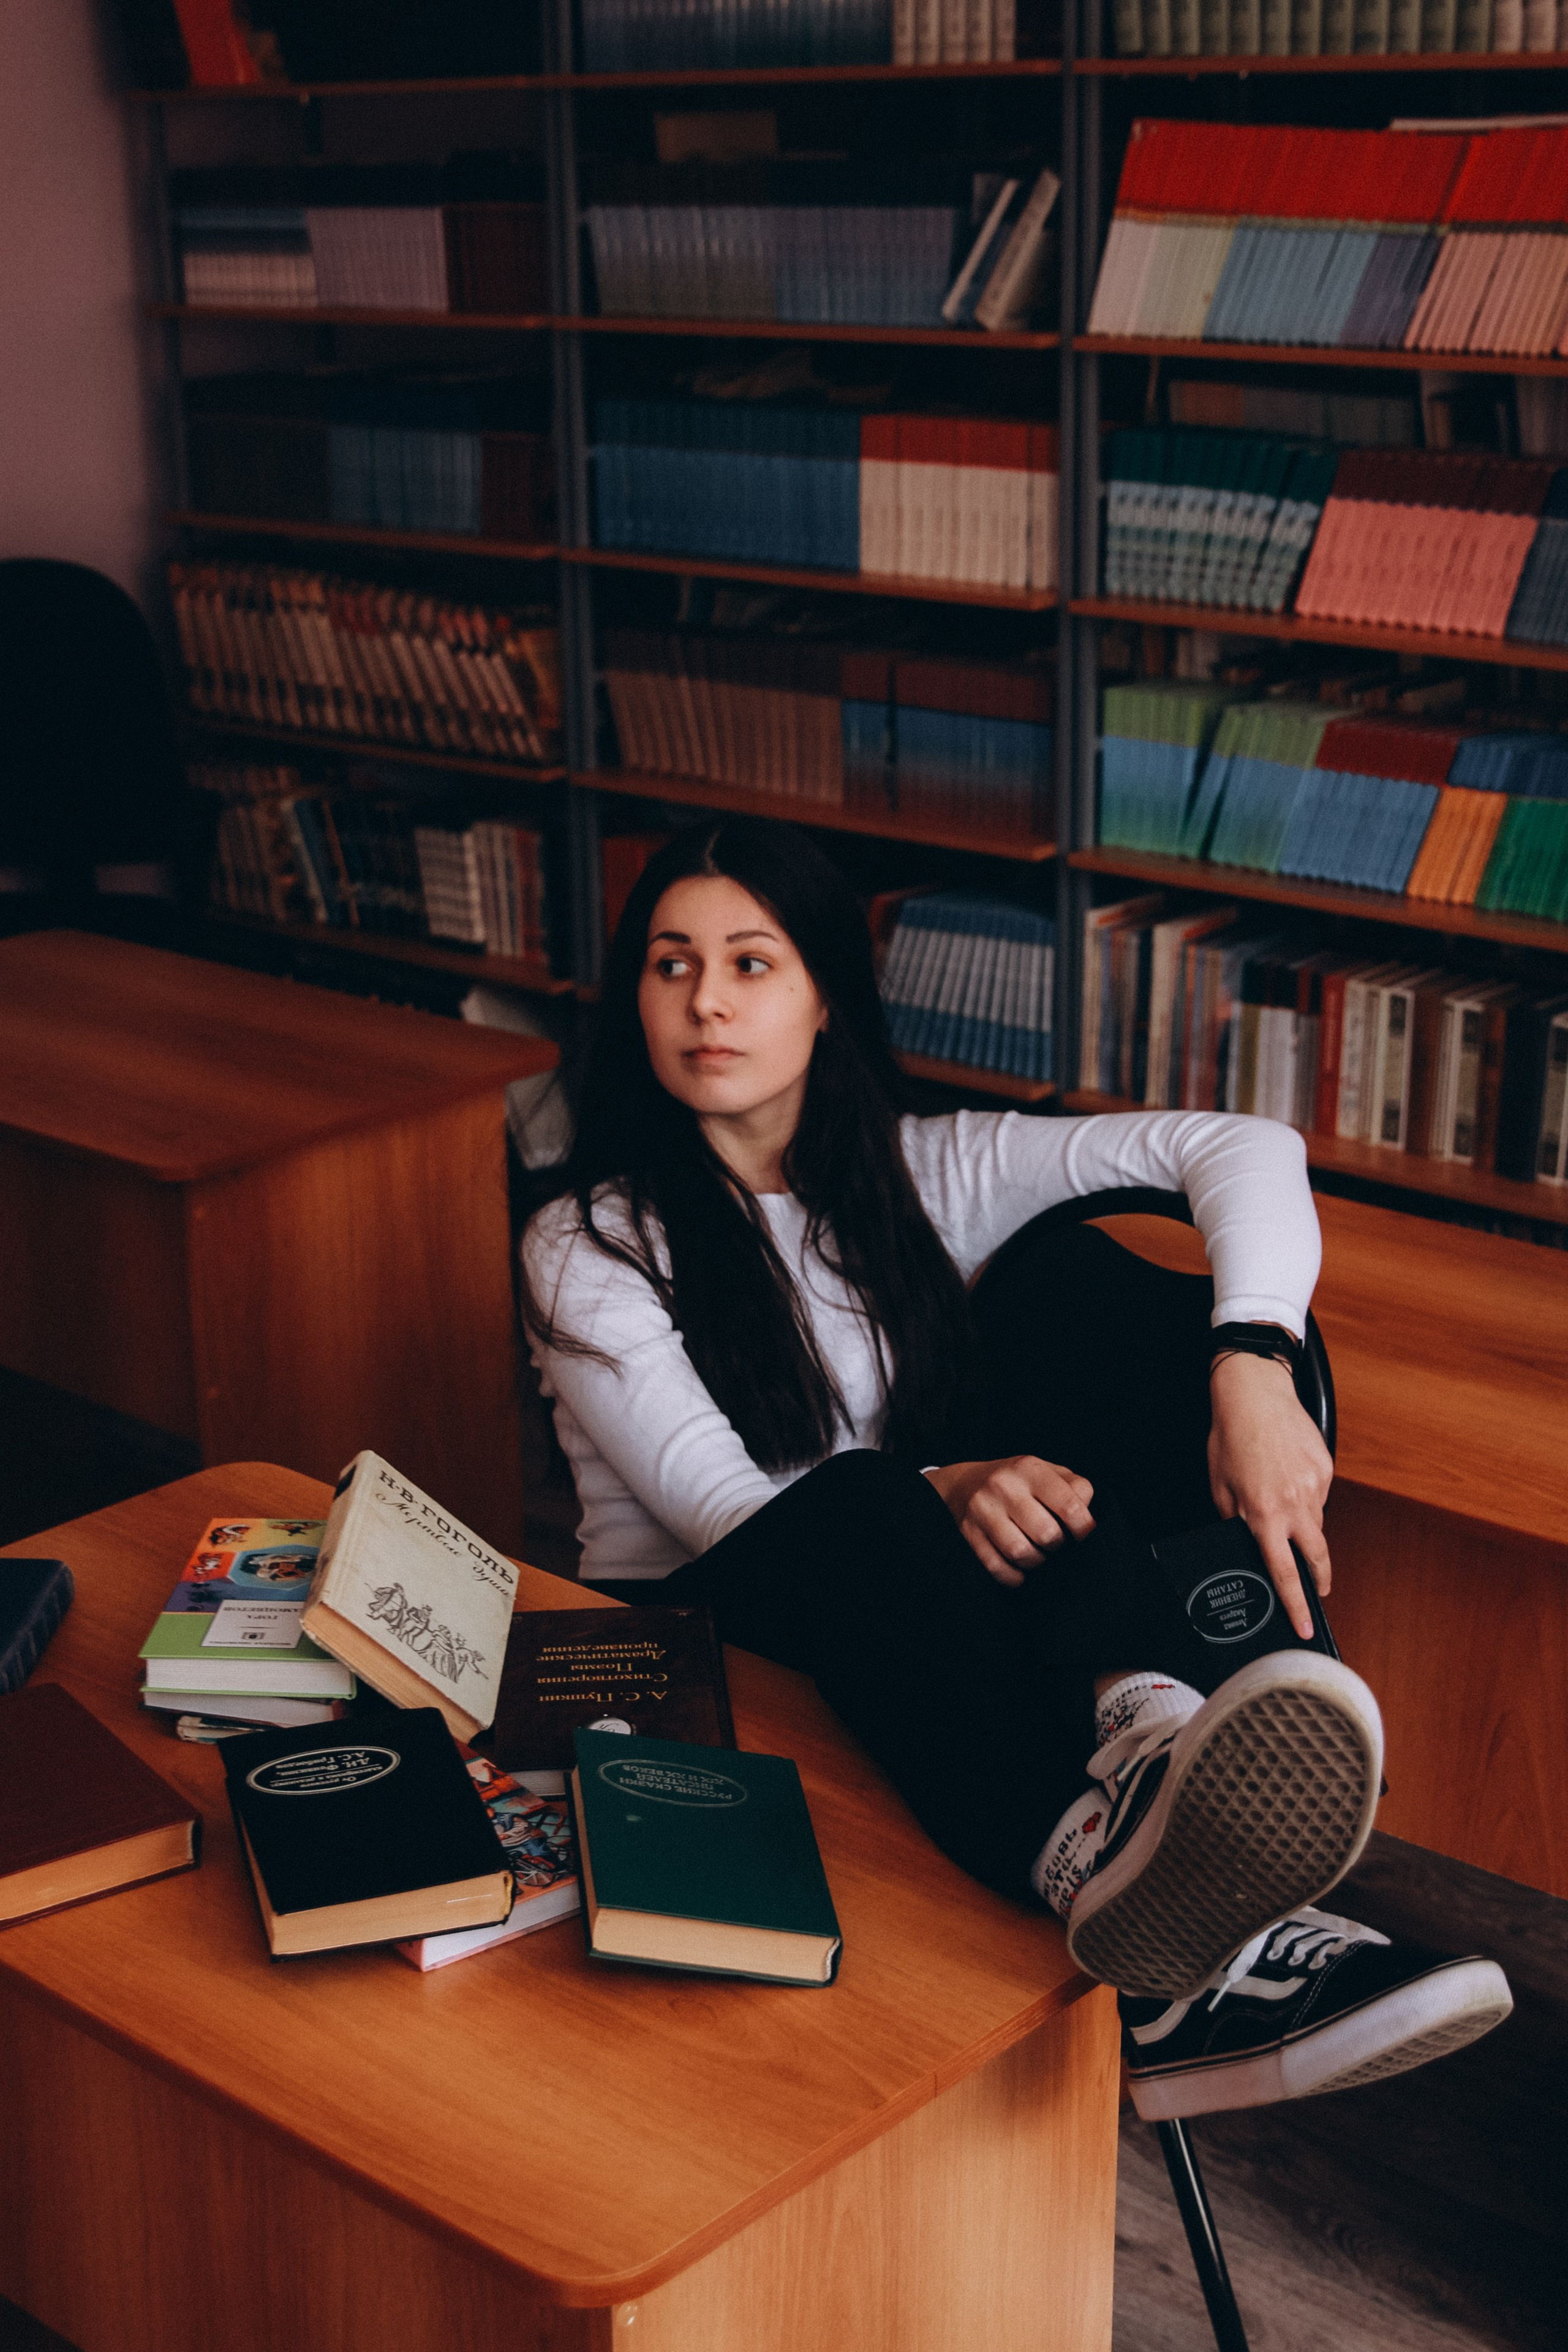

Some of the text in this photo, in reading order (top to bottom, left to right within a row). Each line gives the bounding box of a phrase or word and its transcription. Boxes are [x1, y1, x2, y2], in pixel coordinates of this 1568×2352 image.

[375, 1493, 461, 1558] Мертвые
[421, 1504, 513, 1584] ГОГОЛЬ
[1207, 1580, 1244, 1598] САТАНЫ
[1210, 1589, 1246, 1608] ДНЕВНИК
[543, 1642, 658, 1653] произведения
[537, 1650, 666, 1661] Драматические
[571, 1663, 632, 1672] Поэмы
[537, 1673, 668, 1683] Стихотворения
[538, 1691, 668, 1702] А. С. Пушкин
[623, 1765, 664, 1776] ВЕКОВ
[619, 1777, 732, 1800] РУССКИЕ СКАЗКИ
[637, 1773, 714, 1790] ПИСАТЕЛЕЙ
